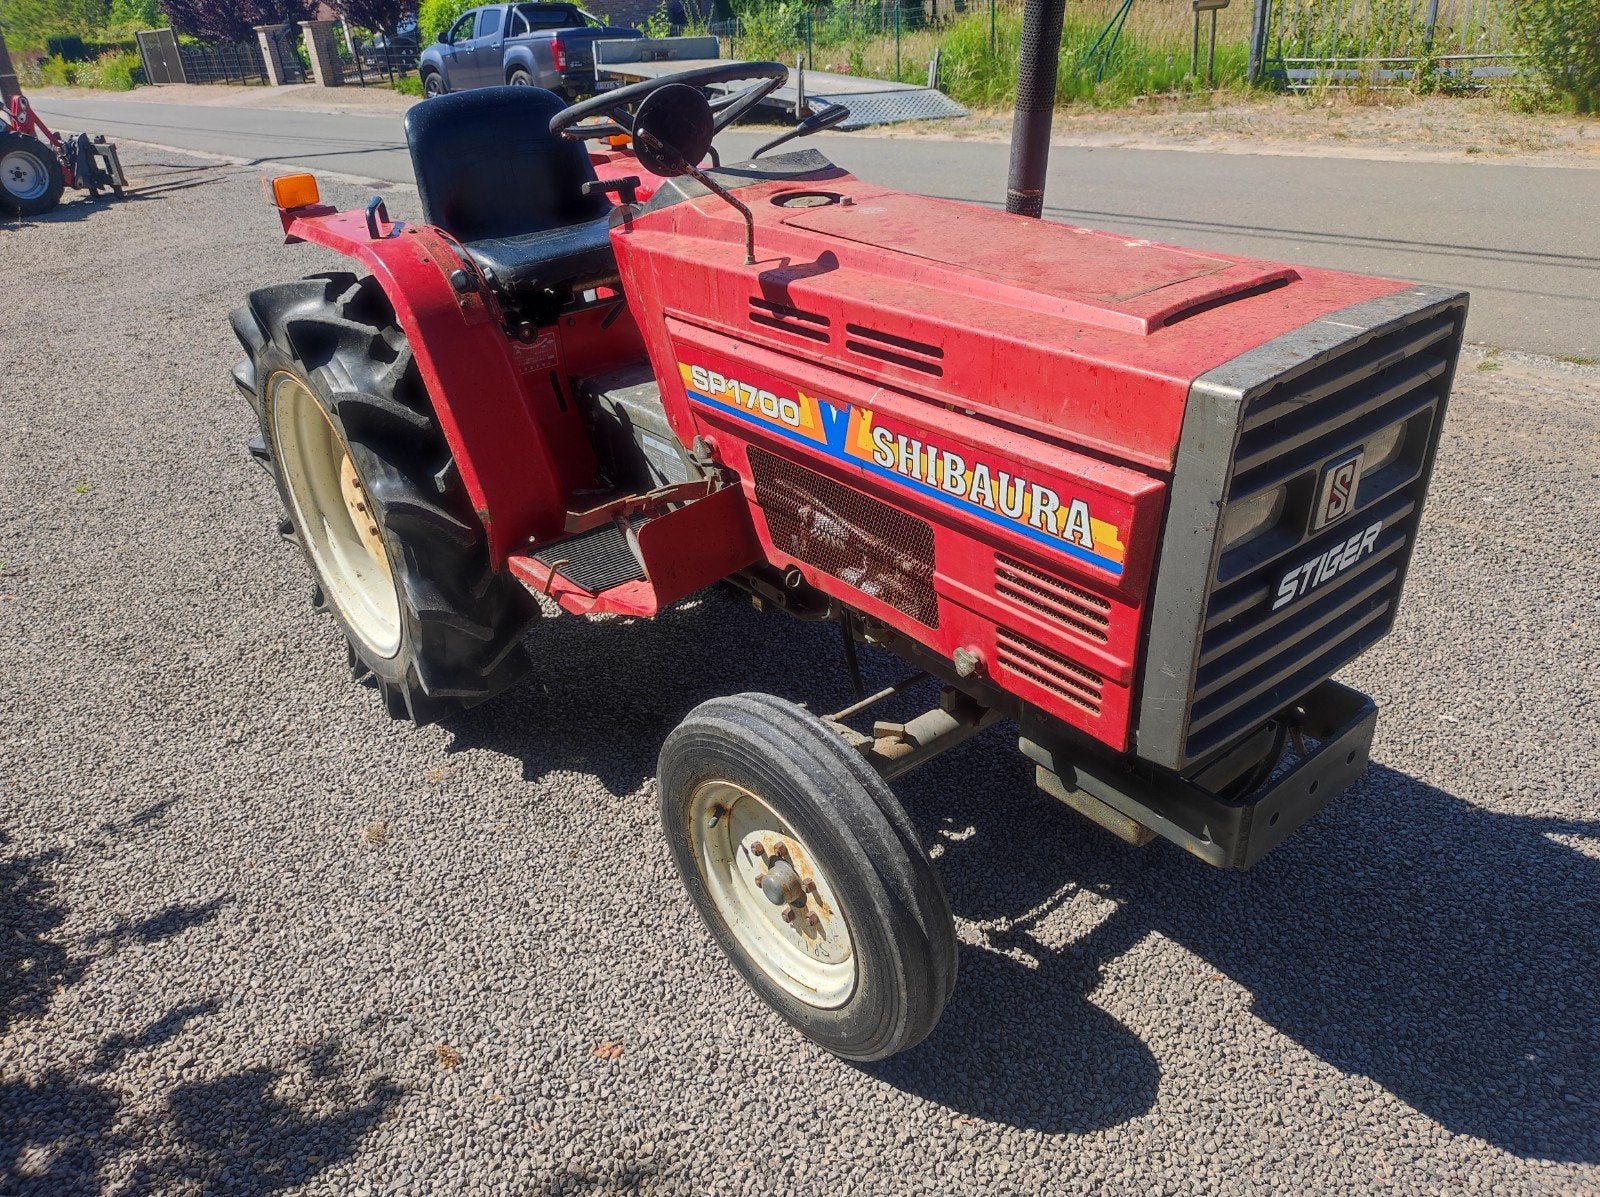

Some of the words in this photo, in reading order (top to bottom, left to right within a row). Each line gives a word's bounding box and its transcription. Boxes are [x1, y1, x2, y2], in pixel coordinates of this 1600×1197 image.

[691, 364, 800, 427] SP1700
[872, 425, 1094, 550] SHIBAURA
[1272, 520, 1383, 611] STIGER
